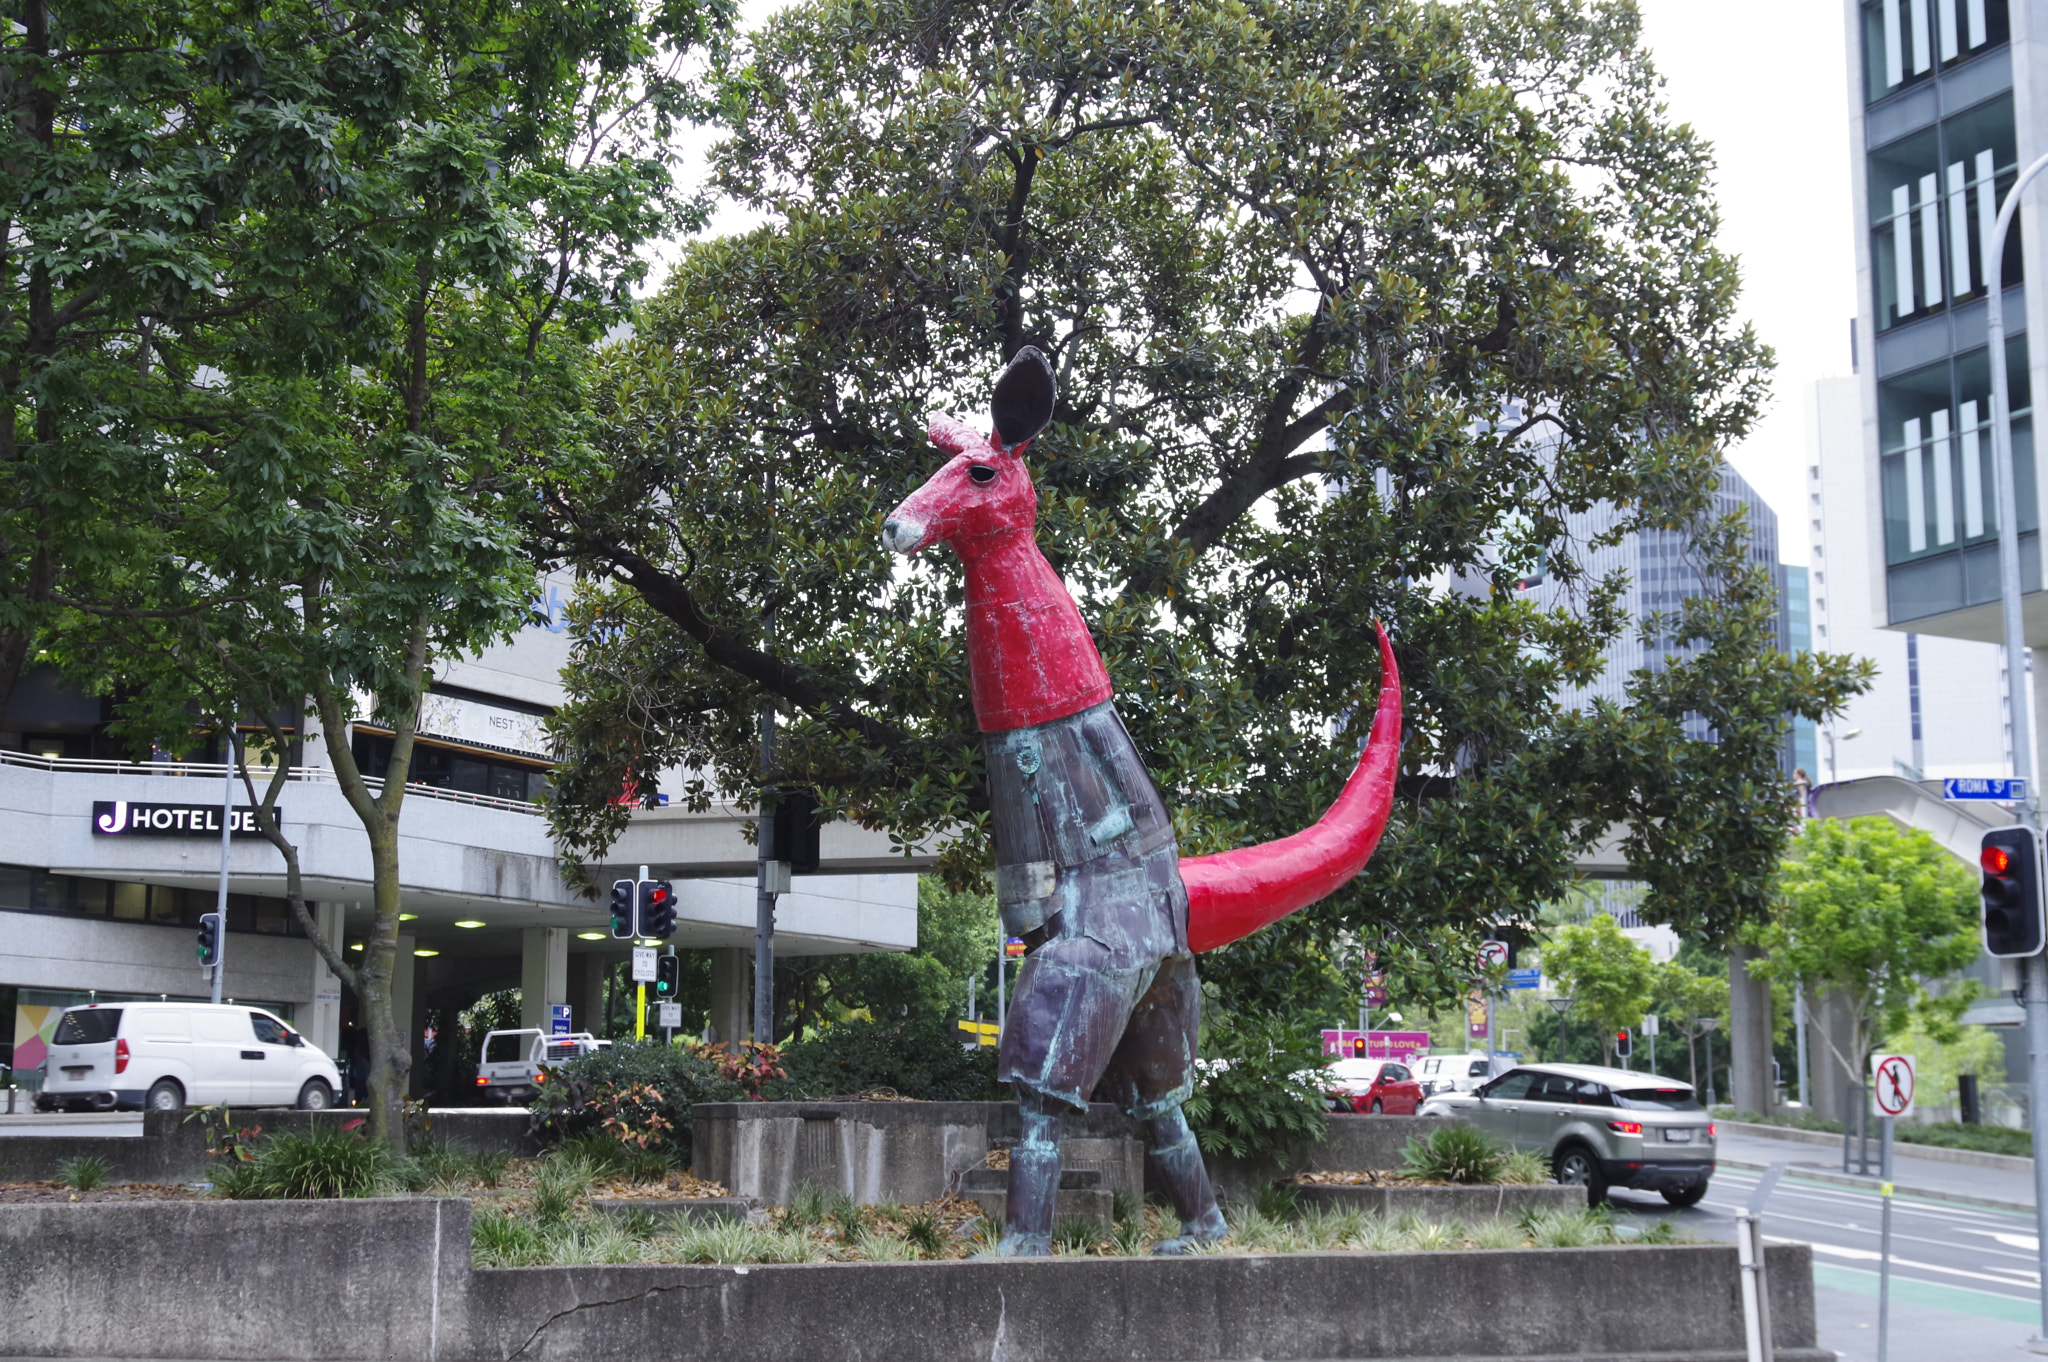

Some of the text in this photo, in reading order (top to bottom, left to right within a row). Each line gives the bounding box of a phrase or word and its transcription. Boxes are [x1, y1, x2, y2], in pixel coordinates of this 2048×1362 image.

[489, 715, 514, 731] NEST
[1957, 779, 1990, 793] ROMA
[132, 808, 276, 832] HOTEL JE
[646, 951, 655, 959] WAY
[634, 969, 655, 977] CYCLISTS
[563, 1007, 570, 1018] P
[1395, 1041, 1416, 1049] LOVE
